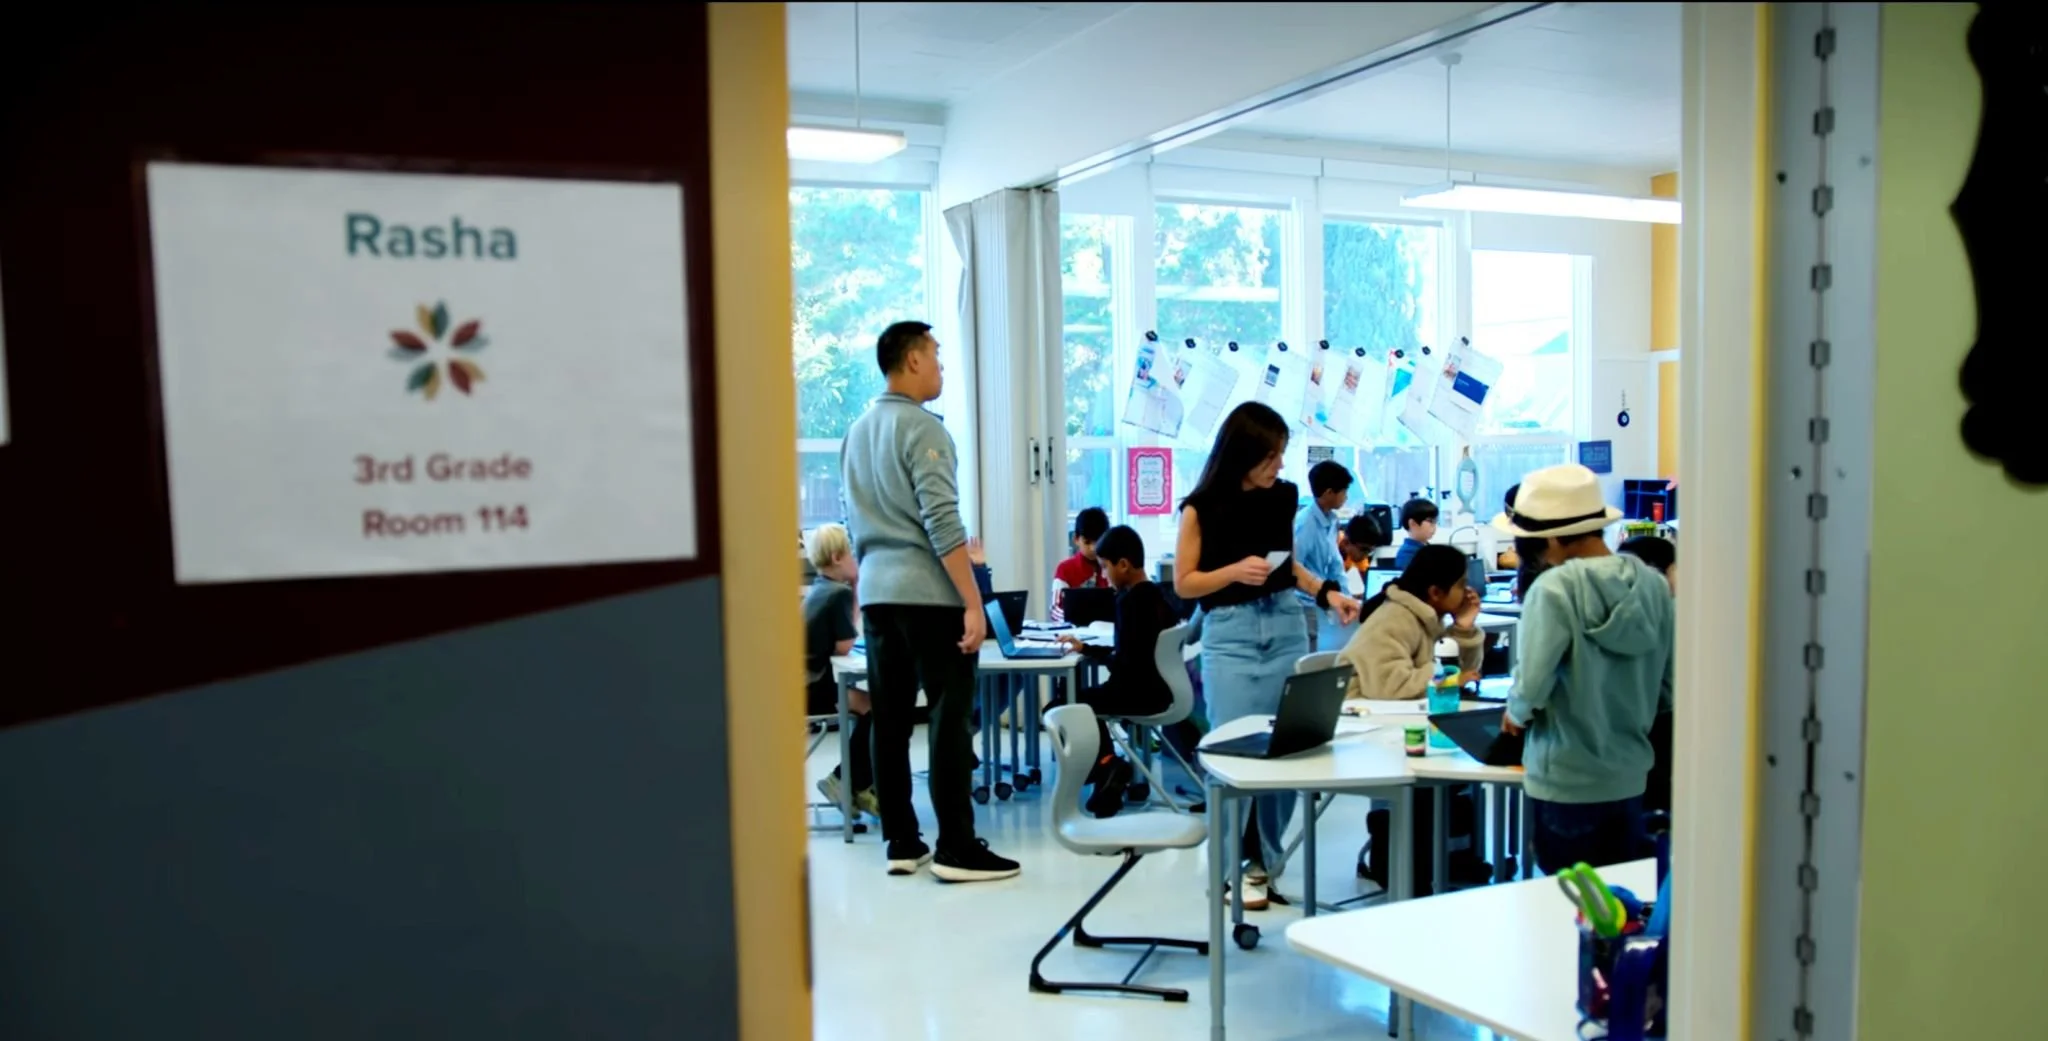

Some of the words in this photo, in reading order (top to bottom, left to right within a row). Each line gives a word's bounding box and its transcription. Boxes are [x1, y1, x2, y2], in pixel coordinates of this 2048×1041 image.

[345, 211, 517, 259] Rasha
[355, 454, 414, 484] 3rd
[426, 452, 532, 482] Grade
[363, 508, 464, 537] Room
[476, 504, 529, 532] 114
